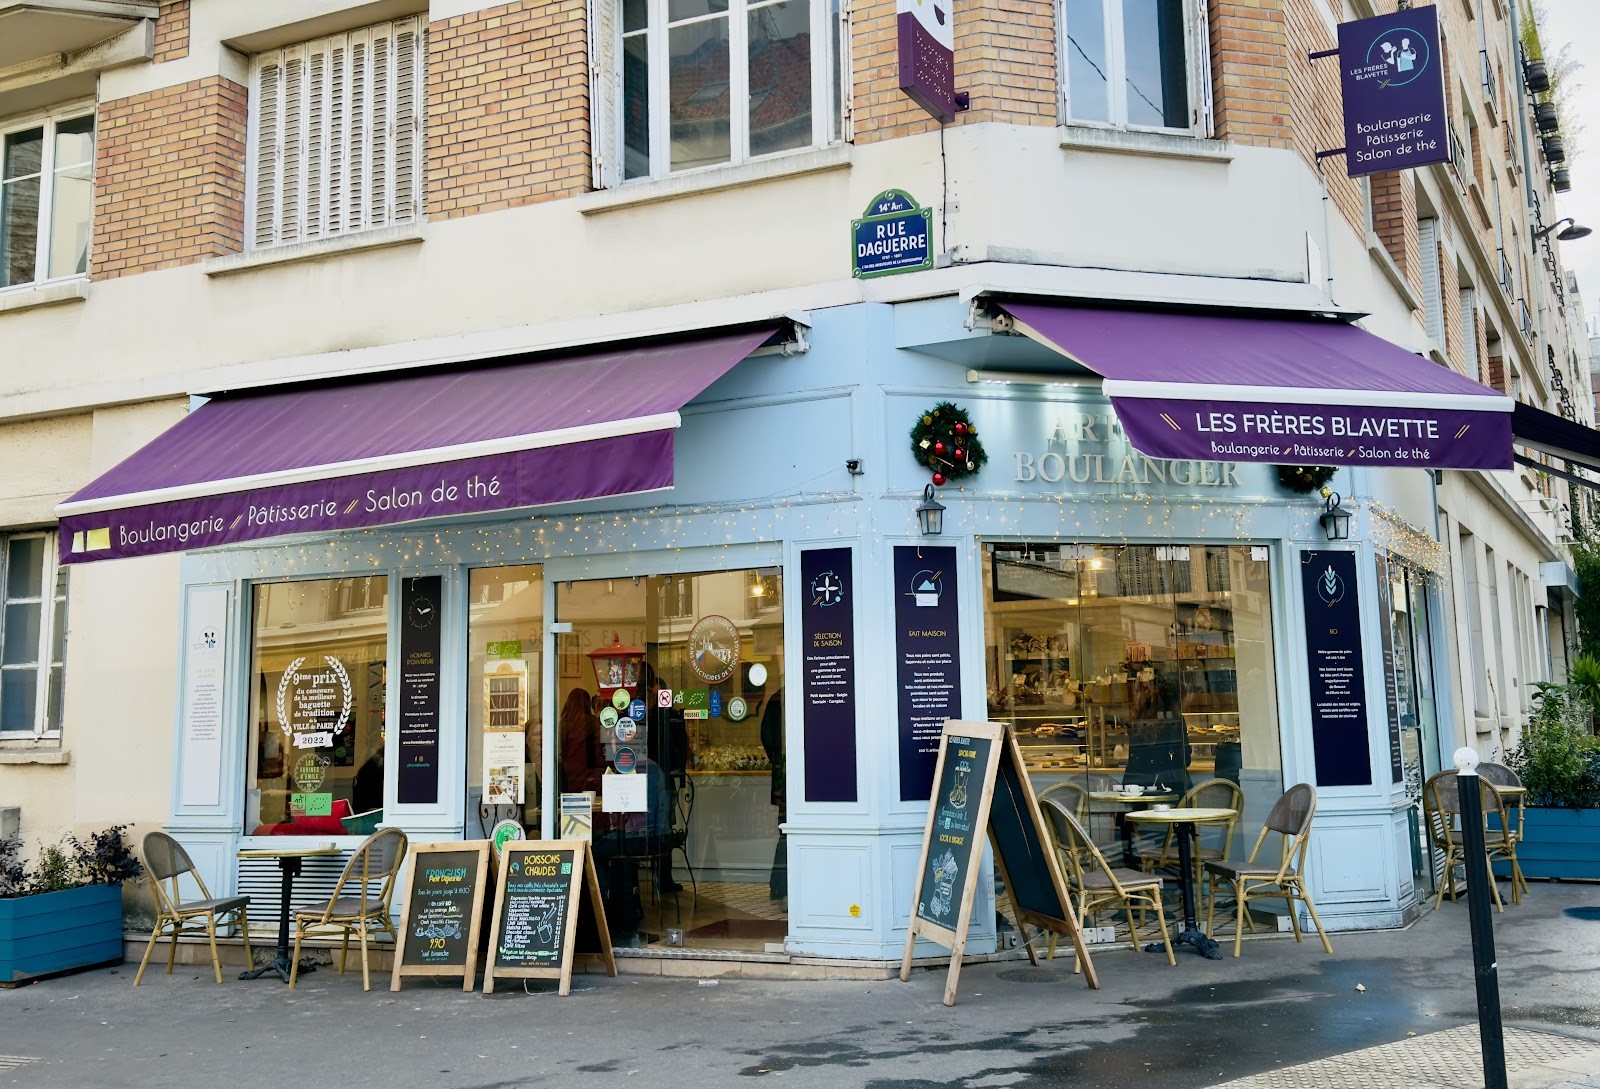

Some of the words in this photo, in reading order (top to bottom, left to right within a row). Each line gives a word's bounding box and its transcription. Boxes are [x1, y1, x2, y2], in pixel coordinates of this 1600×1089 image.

[1356, 70, 1388, 80] BLAVETTE
[1364, 63, 1388, 72] FRÈRES
[1357, 113, 1432, 134] Boulangerie
[1366, 128, 1424, 146] Pâtisserie
[1356, 148, 1392, 162] Salon
[1396, 144, 1412, 155] de
[1416, 139, 1437, 152] thé
[876, 221, 906, 238] RUE
[858, 234, 926, 257] DAGUERRE
[1196, 412, 1237, 432] LES
[1242, 410, 1326, 435] FRÈRES
[1332, 416, 1440, 439] BLAVETTE
[1211, 442, 1280, 457] Boulangerie
[1294, 444, 1344, 458] Pâtisserie
[1358, 446, 1392, 459] Salon
[1395, 446, 1408, 459] de
[1411, 446, 1430, 460] thé
[1013, 452, 1244, 486] BOULANGER
[120, 515, 224, 546] Boulangerie
[248, 500, 337, 527] Pâtisserie
[366, 487, 422, 513] Salon
[431, 483, 458, 502] de
[467, 476, 500, 499] thé
[728, 640, 739, 671] STOCKAGE
[313, 671, 337, 687] prix
[692, 660, 720, 680] INSECTICIDES
[299, 701, 330, 710] baguette
[673, 692, 684, 704] AB
[524, 854, 560, 865] BOISSONS
[525, 867, 556, 876] CHAUDES
